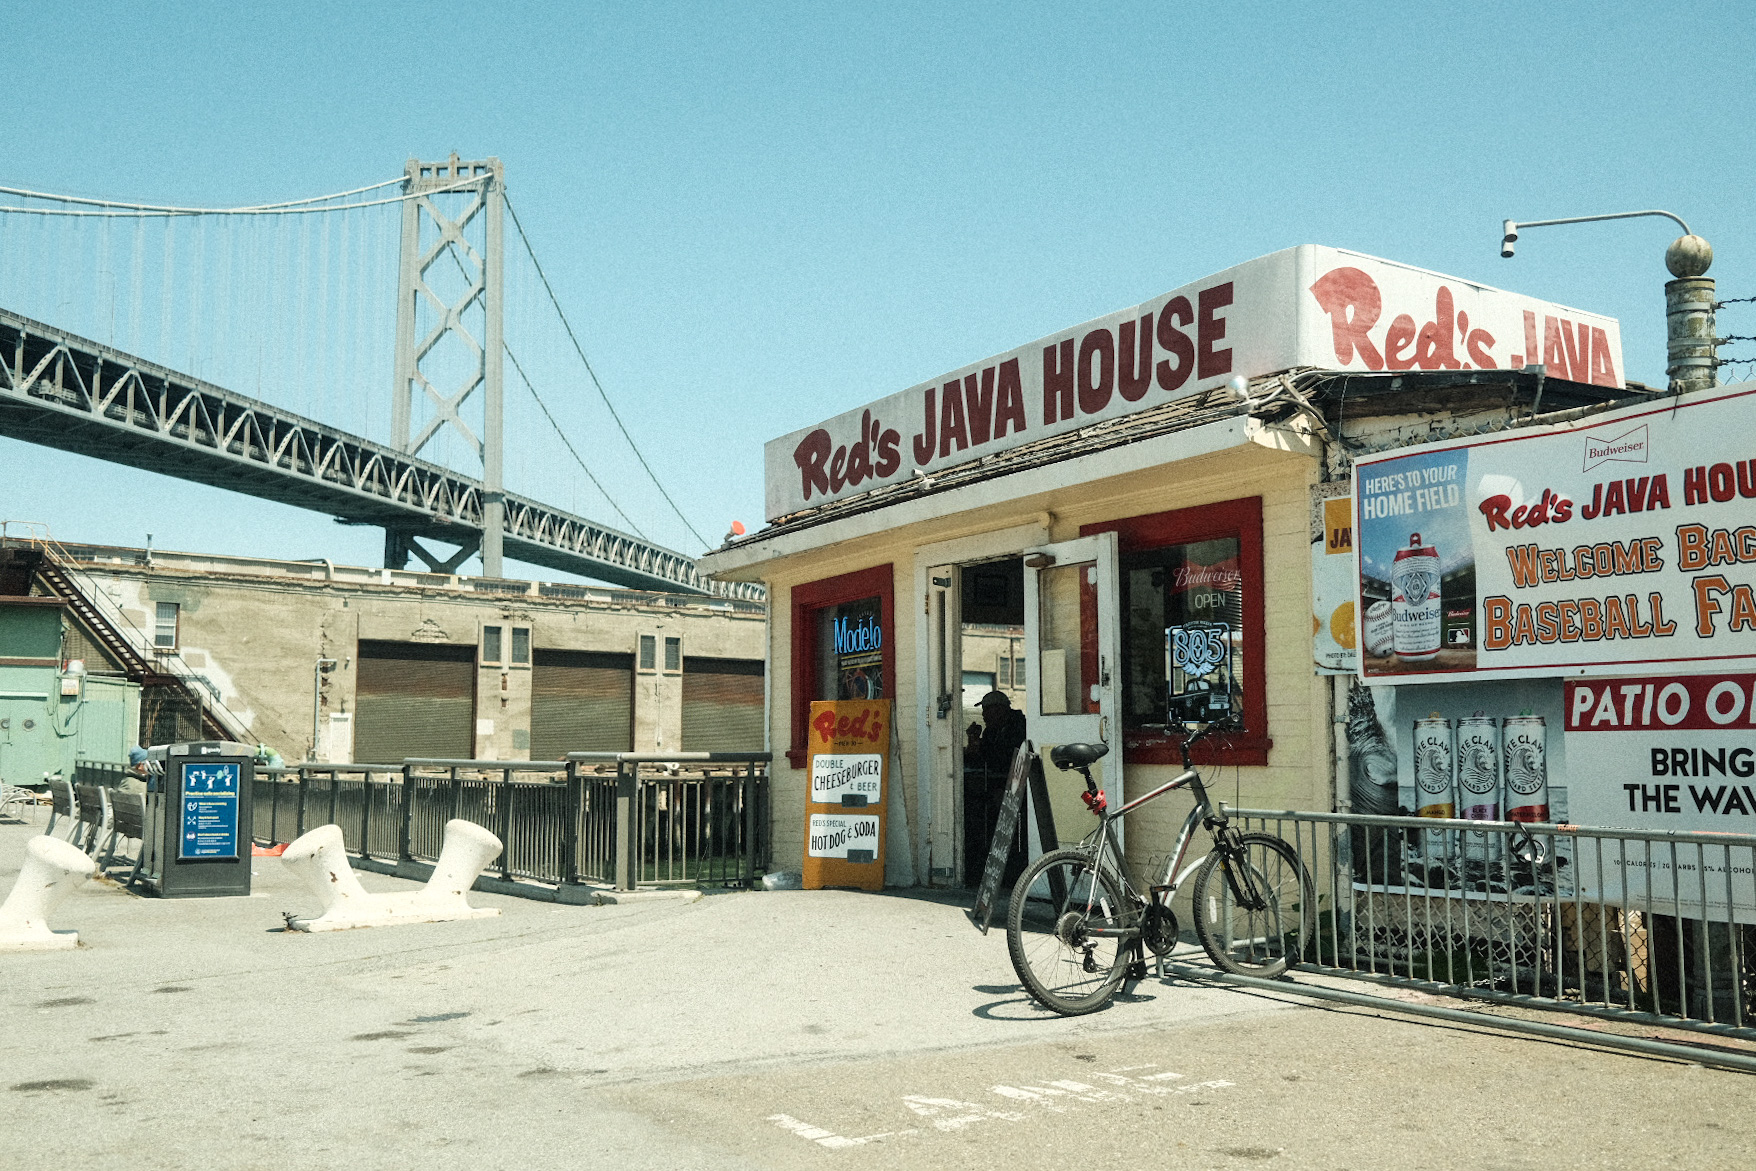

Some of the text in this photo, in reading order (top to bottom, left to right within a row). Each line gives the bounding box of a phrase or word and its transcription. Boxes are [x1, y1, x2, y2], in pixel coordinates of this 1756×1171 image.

[1309, 267, 1626, 390] Red's JAVA
[793, 280, 1234, 501] Red's JAVA HOUSE
[1588, 441, 1644, 459] Budweiser
[1365, 464, 1458, 495] HERE'S TO YOUR
[1363, 483, 1459, 520] HOME FIELD
[1478, 487, 1574, 532] Red's
[1581, 473, 1671, 520] JAVA
[1330, 527, 1352, 549] JA
[1173, 565, 1241, 588] Budweiser
[1506, 537, 1664, 588] WELCOME
[1194, 592, 1226, 609] OPEN
[833, 615, 882, 655] Modelo
[1483, 592, 1677, 651] BASEBALL
[1174, 628, 1225, 665] 805
[1572, 680, 1756, 727] PATIO O
[812, 708, 883, 743] Red's
[1427, 736, 1450, 755] CLAW
[1471, 735, 1495, 755] CLAW
[1518, 734, 1544, 754] CLAW
[814, 759, 879, 792] CHEESEBURGER
[815, 759, 844, 770] DOUBLE
[1651, 747, 1755, 778] BRING
[857, 781, 878, 792] BEER
[1623, 783, 1681, 813] THE
[811, 835, 828, 851] HOT
[829, 828, 847, 850] DOG
[854, 821, 876, 839] SODA
[826, 820, 847, 828] SPECIAL
